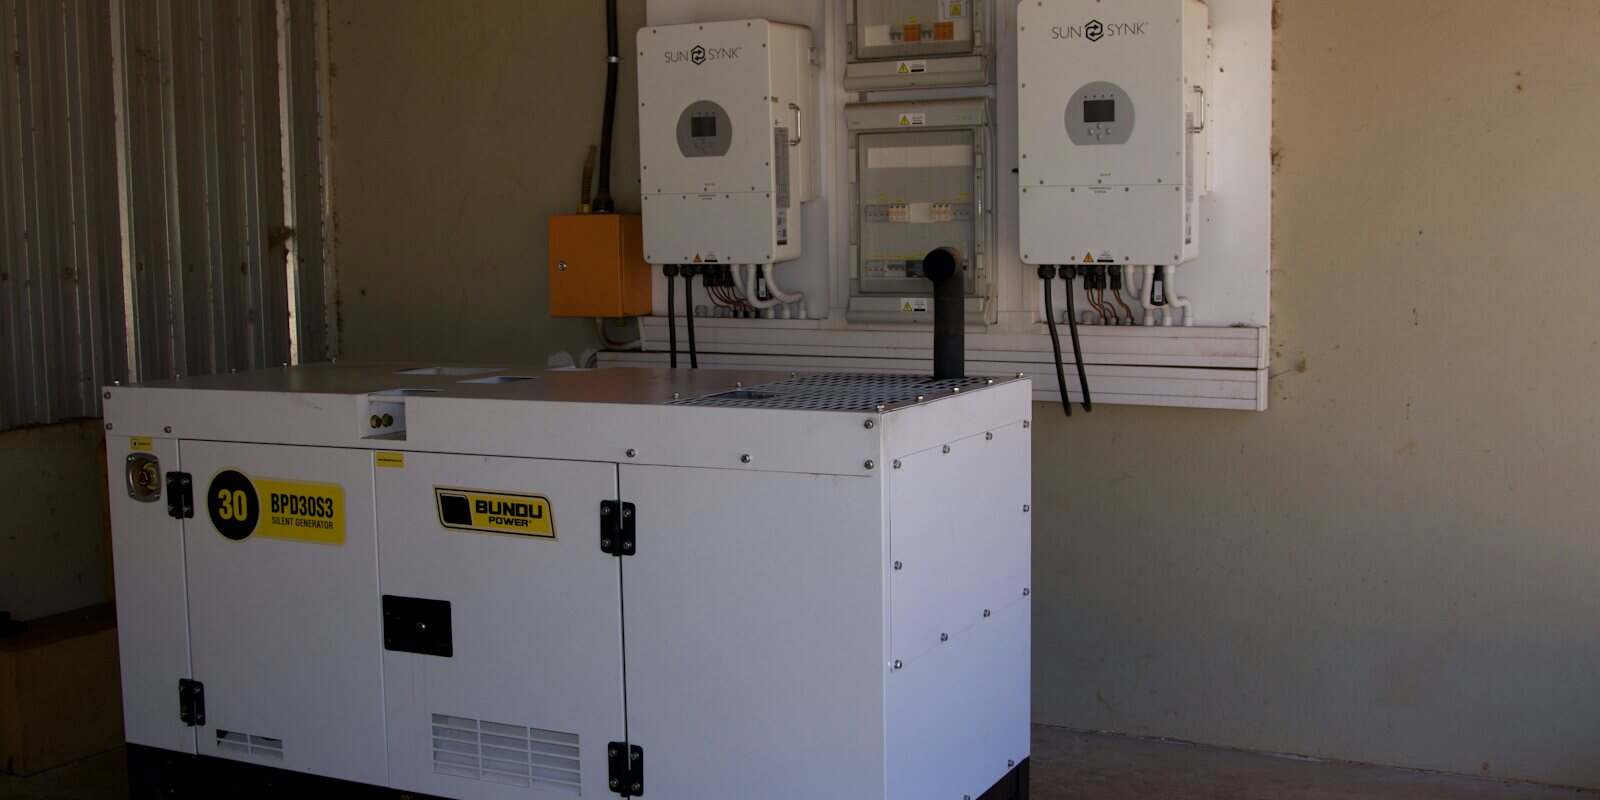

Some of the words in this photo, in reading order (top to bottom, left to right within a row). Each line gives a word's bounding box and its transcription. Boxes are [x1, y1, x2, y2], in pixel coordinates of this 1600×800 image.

[1051, 26, 1082, 40] SUN
[1107, 22, 1145, 37] SYNK
[664, 50, 689, 63] SUN
[708, 47, 740, 61] SYNK
[217, 488, 248, 522] 30
[271, 493, 334, 518] BPD30S3
[475, 499, 543, 519] BUNDU
[271, 516, 294, 527] SILENT
[295, 519, 334, 530] GENERATOR
[488, 516, 529, 528] POWER
